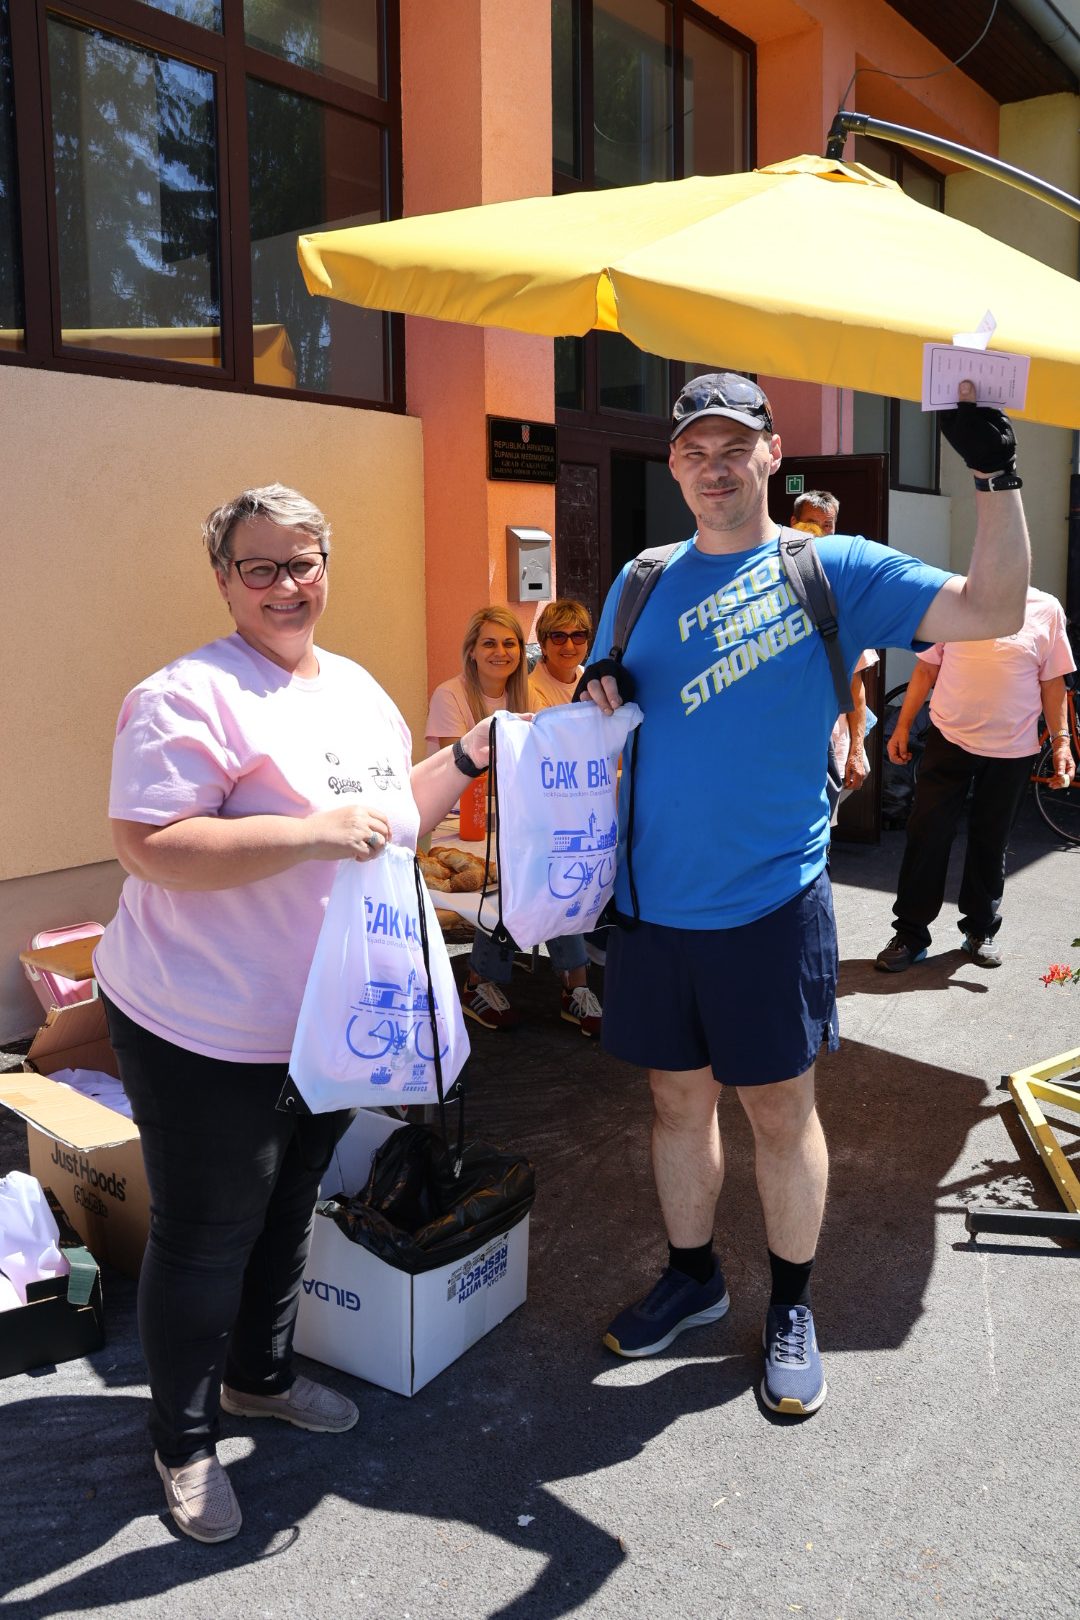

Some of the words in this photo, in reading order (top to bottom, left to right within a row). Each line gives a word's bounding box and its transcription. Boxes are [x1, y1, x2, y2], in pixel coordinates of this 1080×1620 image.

[494, 440, 525, 450] REPUBLIKA
[526, 444, 555, 453] HRVATSKA
[541, 756, 578, 789] ČAK
[587, 757, 611, 788] BA
[458, 1245, 509, 1292] RESPECT
[482, 1259, 508, 1285] MADE
[458, 1282, 482, 1304] WITH
